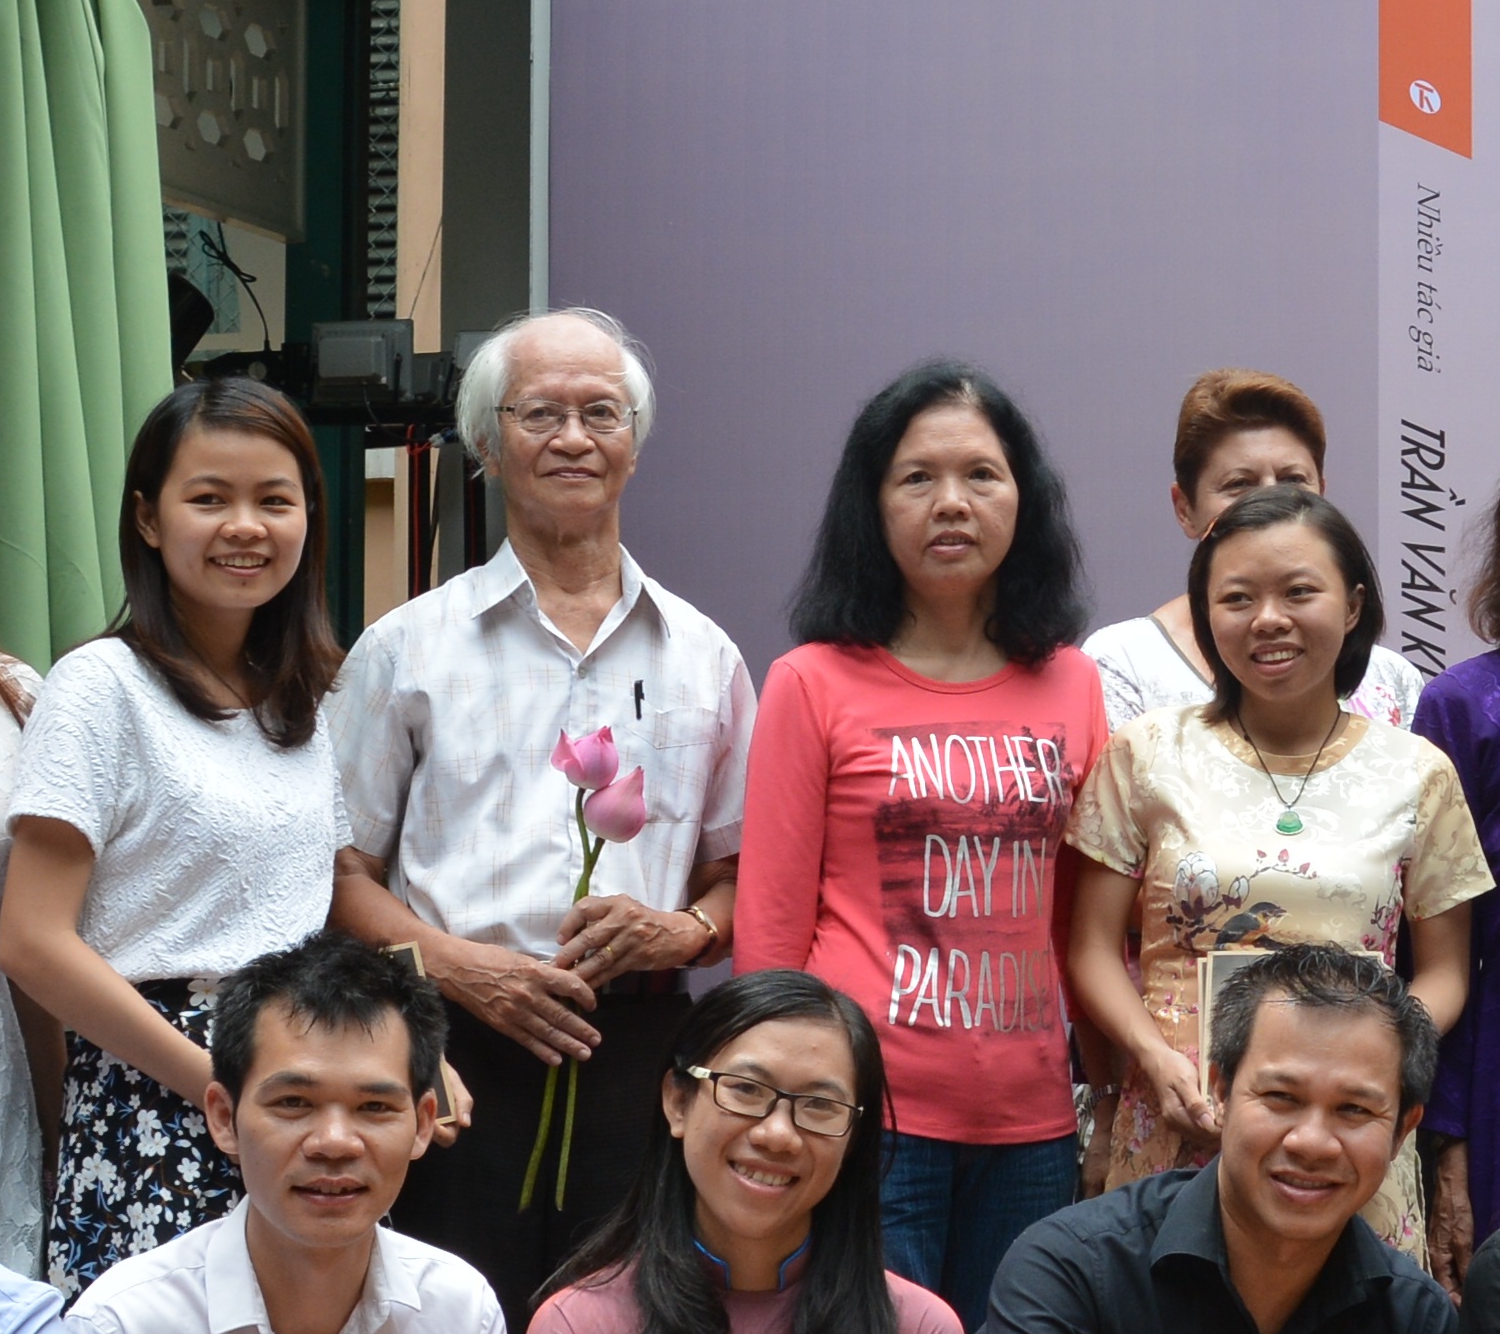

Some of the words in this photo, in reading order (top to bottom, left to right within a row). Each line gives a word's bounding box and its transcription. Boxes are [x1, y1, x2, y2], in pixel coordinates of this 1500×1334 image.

[1416, 181, 1443, 273] Nhiều
[1416, 279, 1443, 323] tác
[1408, 324, 1442, 374] giả
[1400, 418, 1467, 533] TRẦN
[1400, 541, 1457, 633] VĂN
[888, 733, 1065, 805] ANOTHER
[923, 834, 1000, 919] DAY
[1012, 837, 1047, 918] IN
[888, 944, 1052, 1033] PARADISE
